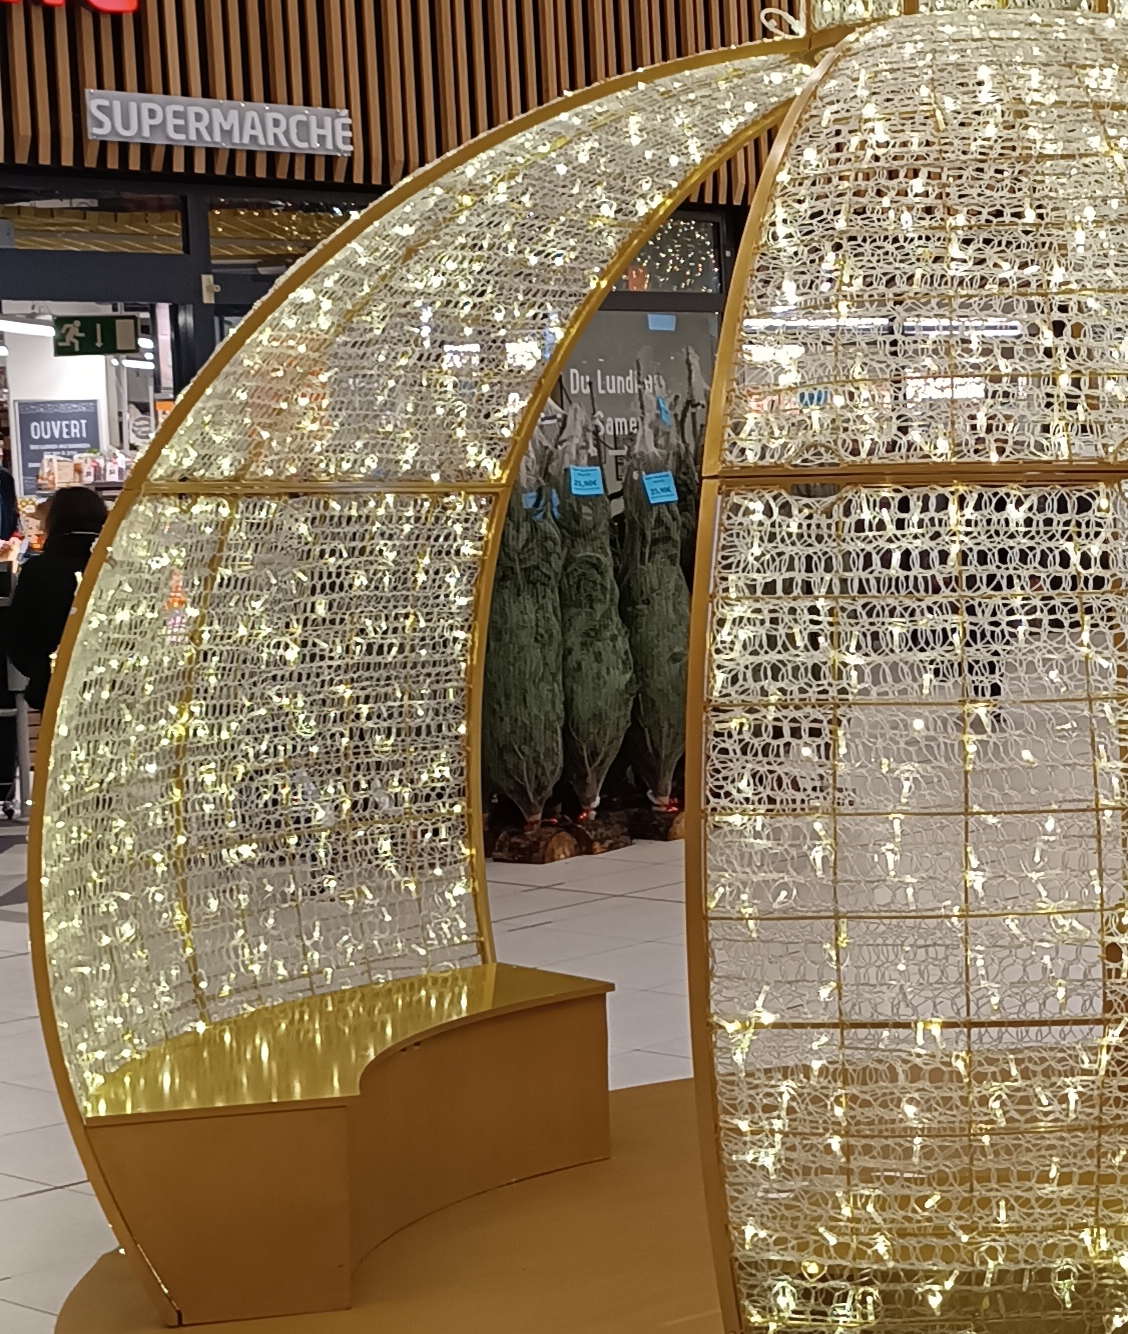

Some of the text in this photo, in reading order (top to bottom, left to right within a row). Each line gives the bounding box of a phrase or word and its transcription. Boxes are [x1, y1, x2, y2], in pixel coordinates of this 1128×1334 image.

[90, 98, 354, 152] SUPERMARCHÉ
[570, 368, 591, 394] Du
[597, 369, 638, 394] Lundi
[30, 419, 87, 440] OUVERT
[594, 410, 640, 436] Same
